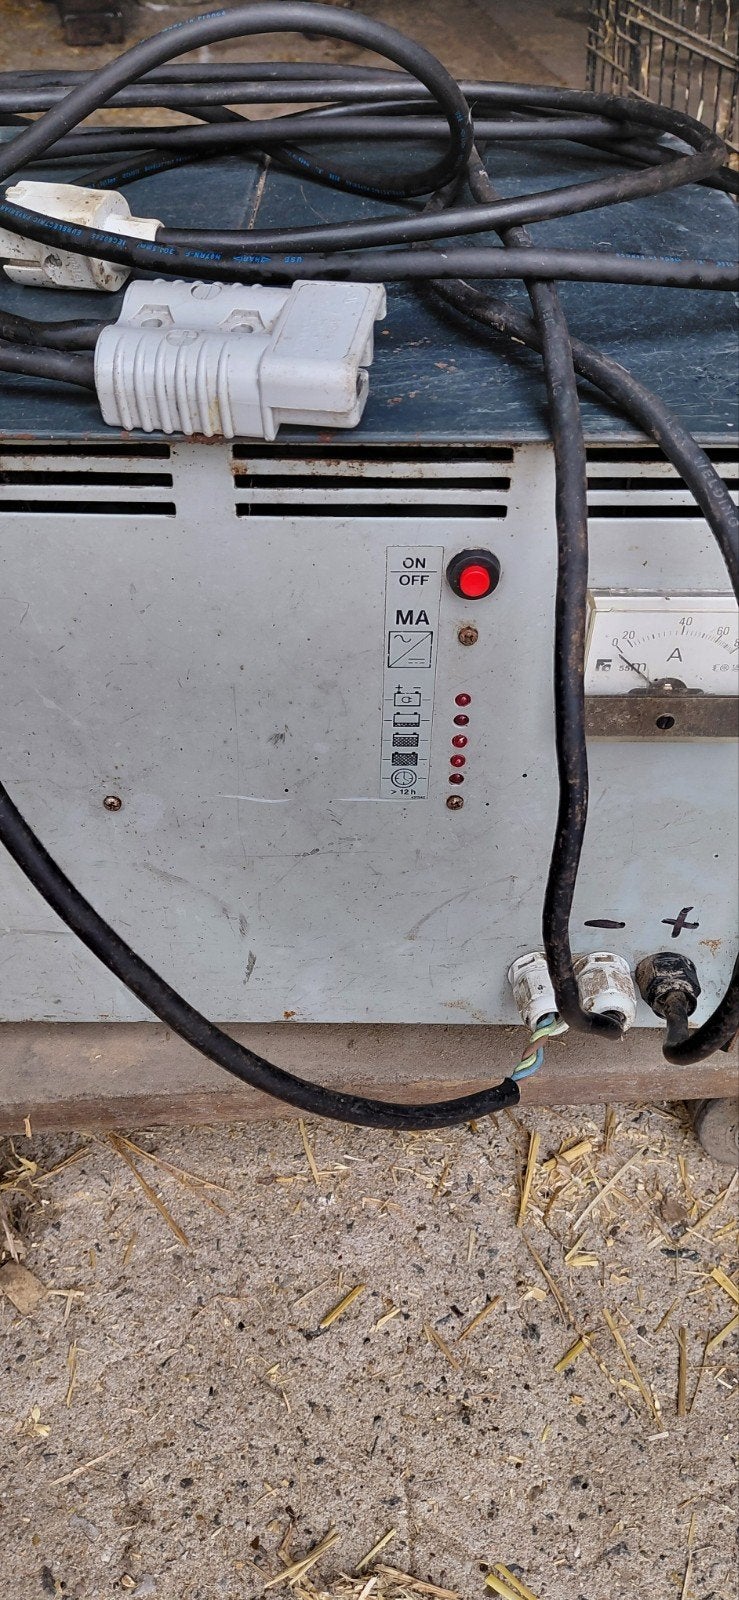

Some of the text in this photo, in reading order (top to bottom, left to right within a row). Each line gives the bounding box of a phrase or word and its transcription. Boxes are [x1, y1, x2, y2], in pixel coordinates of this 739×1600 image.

[283, 256, 304, 265] USE
[403, 557, 426, 569] ON
[399, 574, 430, 586] OFF
[395, 609, 430, 625] MA
[679, 616, 693, 626] 40
[622, 630, 635, 640] 20
[716, 626, 730, 636] 60
[611, 637, 618, 647] 0
[666, 647, 683, 662] A
